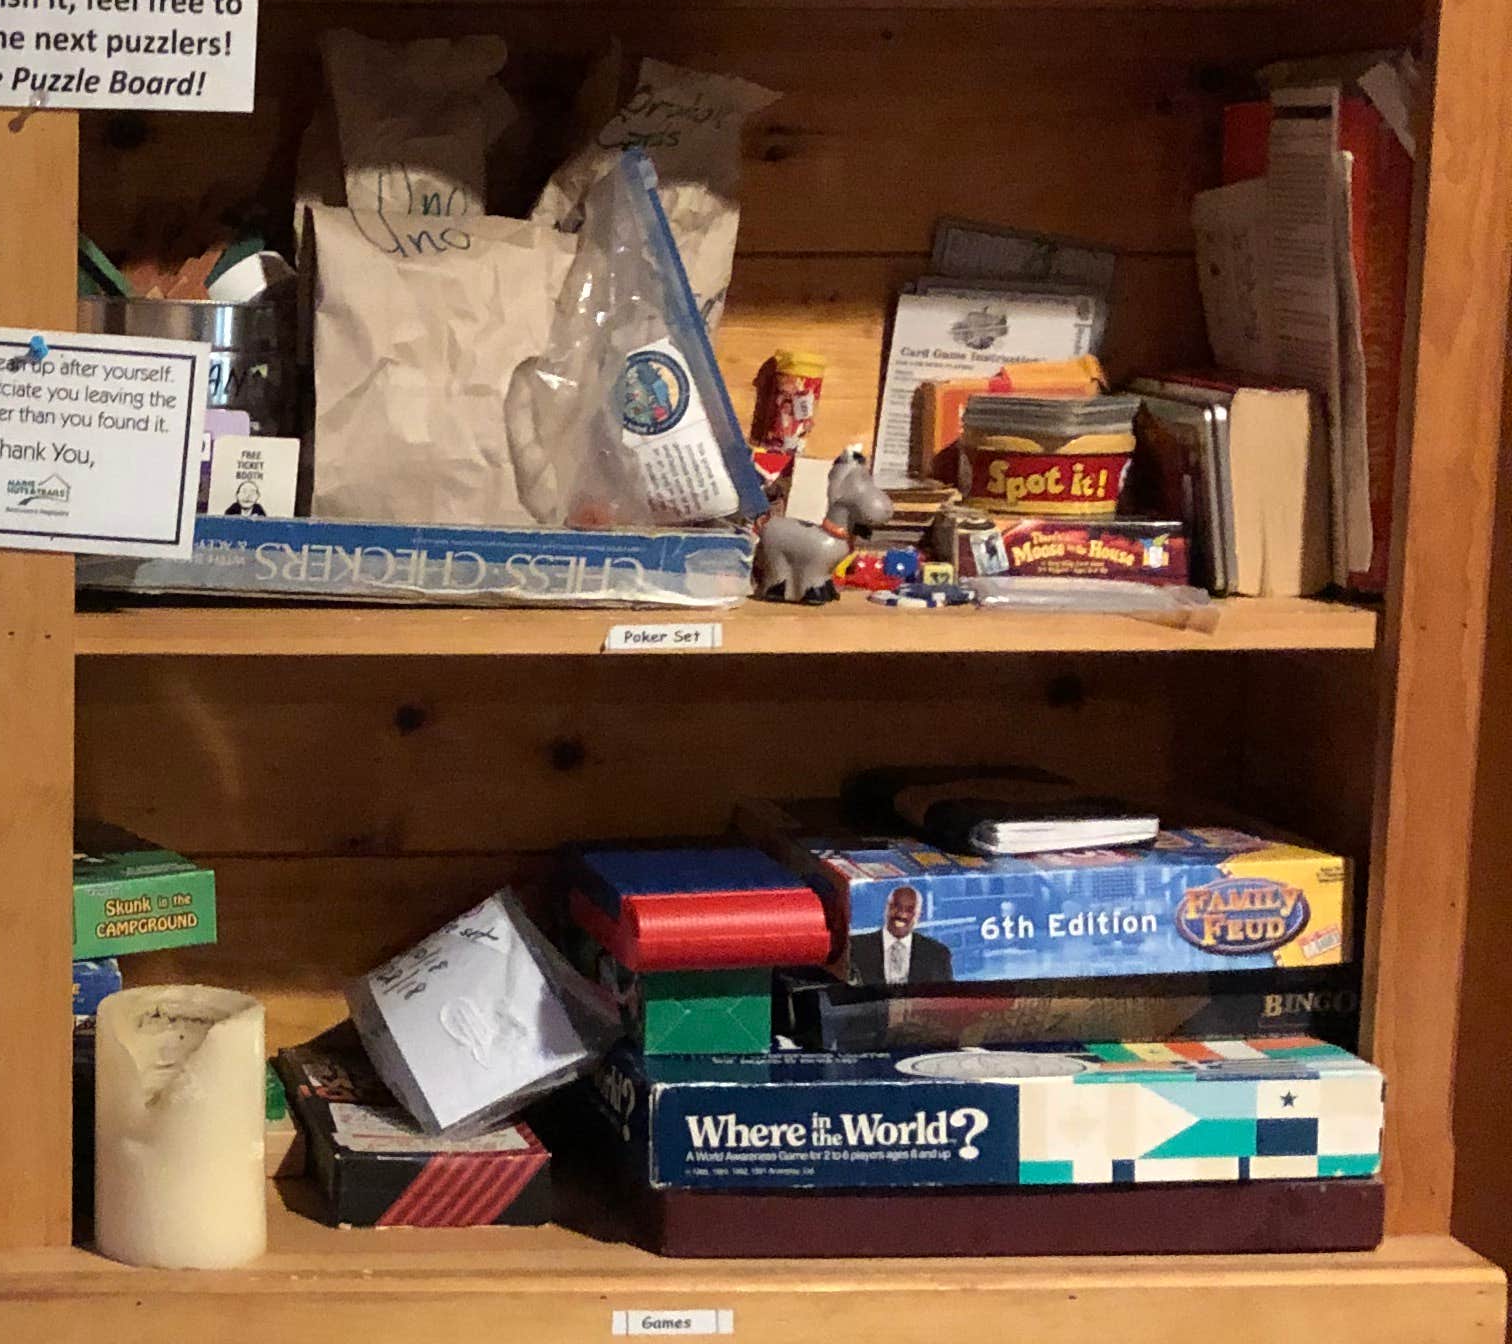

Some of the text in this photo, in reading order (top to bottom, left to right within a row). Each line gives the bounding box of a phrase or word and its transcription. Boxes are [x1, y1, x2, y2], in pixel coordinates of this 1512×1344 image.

[34, 29, 98, 53] next
[105, 30, 234, 58] puzzlers!
[10, 67, 102, 94] Puzzle
[108, 70, 208, 96] Board!
[899, 346, 967, 360] Card Game
[59, 356, 98, 377] after
[102, 362, 176, 386] yourself.
[46, 383, 80, 405] you
[83, 385, 145, 411] leaving
[148, 390, 178, 410] the
[18, 406, 56, 426] than
[59, 411, 93, 431] you
[96, 409, 146, 432] found
[153, 413, 170, 434] it.
[51, 441, 96, 468] You,
[987, 459, 1109, 505] Spot it!
[622, 628, 702, 643] Poker Set
[106, 893, 152, 916] Skunk
[1182, 878, 1305, 920] FAMILY
[96, 912, 200, 939] CAMPGROUND
[980, 908, 1160, 943] 6th Edition
[1201, 912, 1289, 946] FEUD
[686, 1112, 843, 1148] Where the
[641, 1315, 693, 1331] Games
